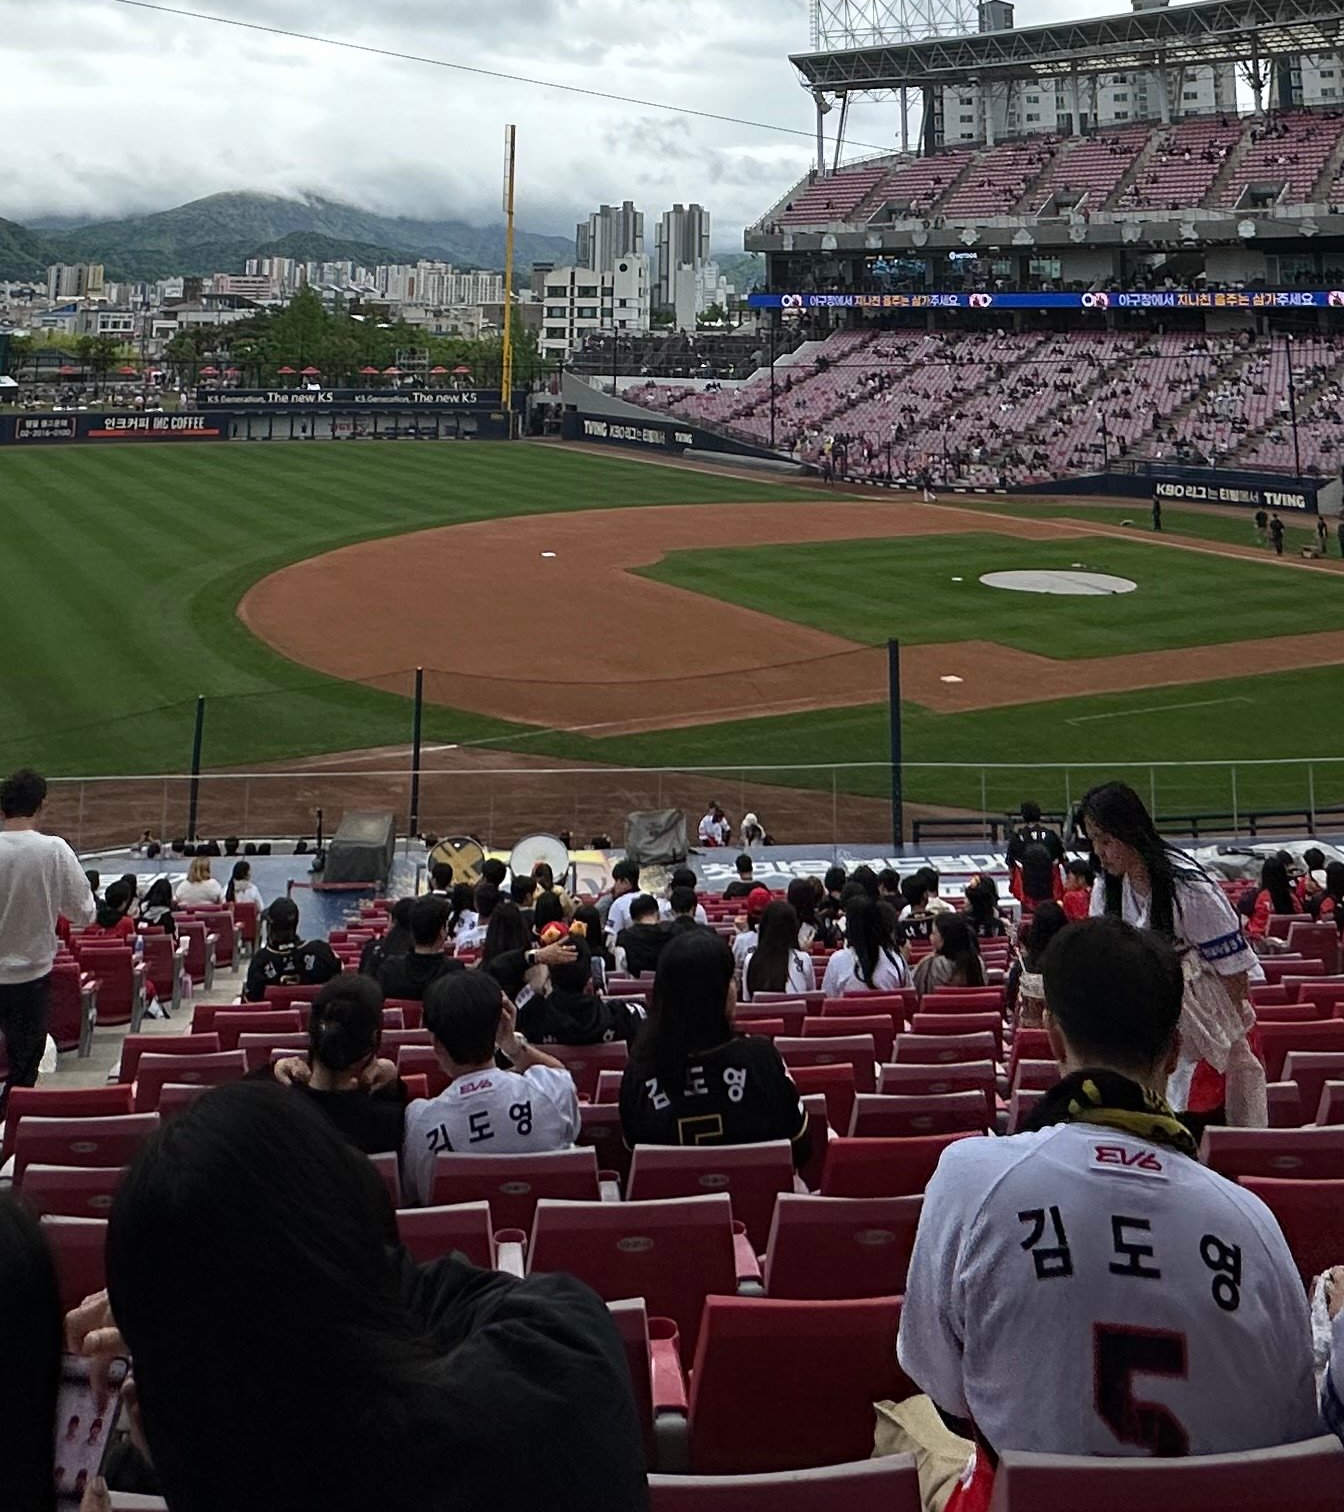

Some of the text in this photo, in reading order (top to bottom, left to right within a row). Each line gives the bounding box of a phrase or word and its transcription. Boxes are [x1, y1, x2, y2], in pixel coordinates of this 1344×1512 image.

[1118, 294, 1174, 307] 야구장에서
[1177, 294, 1211, 307] 지나친
[1215, 294, 1249, 307] 음주는
[267, 391, 289, 403] The
[290, 394, 314, 403] new
[317, 392, 333, 403] K5
[412, 392, 433, 403] The
[434, 394, 459, 403] new
[461, 392, 478, 403] K5
[105, 416, 205, 430] 인크커피 COFFEE
[1156, 483, 1184, 497] KBO
[1264, 491, 1305, 508] TVING
[1095, 1146, 1162, 1171] EV6
[1093, 1322, 1189, 1456] 5
